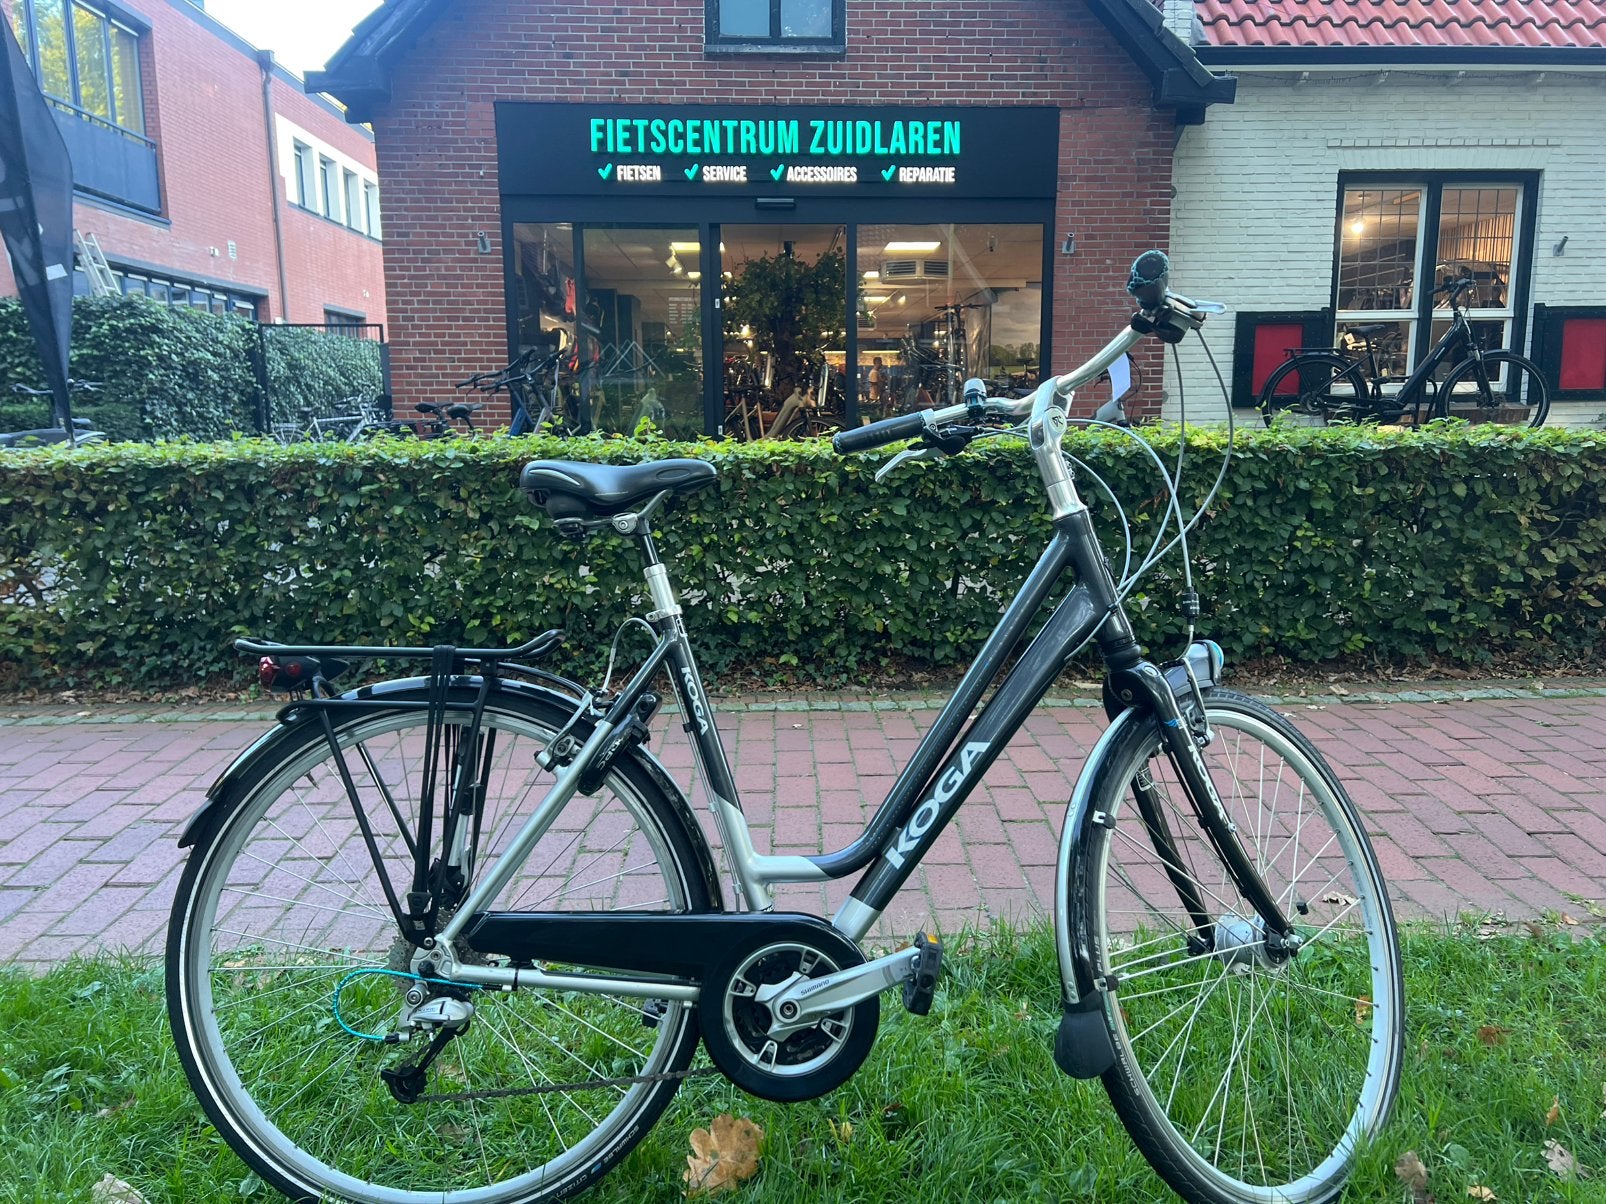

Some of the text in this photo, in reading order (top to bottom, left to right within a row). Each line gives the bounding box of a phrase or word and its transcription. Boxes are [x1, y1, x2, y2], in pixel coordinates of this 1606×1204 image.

[590, 118, 961, 154] FIETSCENTRUM ZUIDLAREN
[616, 164, 662, 182] FIETSEN
[702, 165, 748, 182] SERVICE
[786, 166, 858, 183] ACCESSOIRES
[899, 166, 956, 183] REPARATIE
[681, 666, 709, 736] KOGA
[1187, 744, 1227, 823] KOGA
[885, 741, 992, 870] KOGA
[1112, 1033, 1140, 1097] SCHWALBE
[603, 1124, 640, 1164] SCHWALBE
